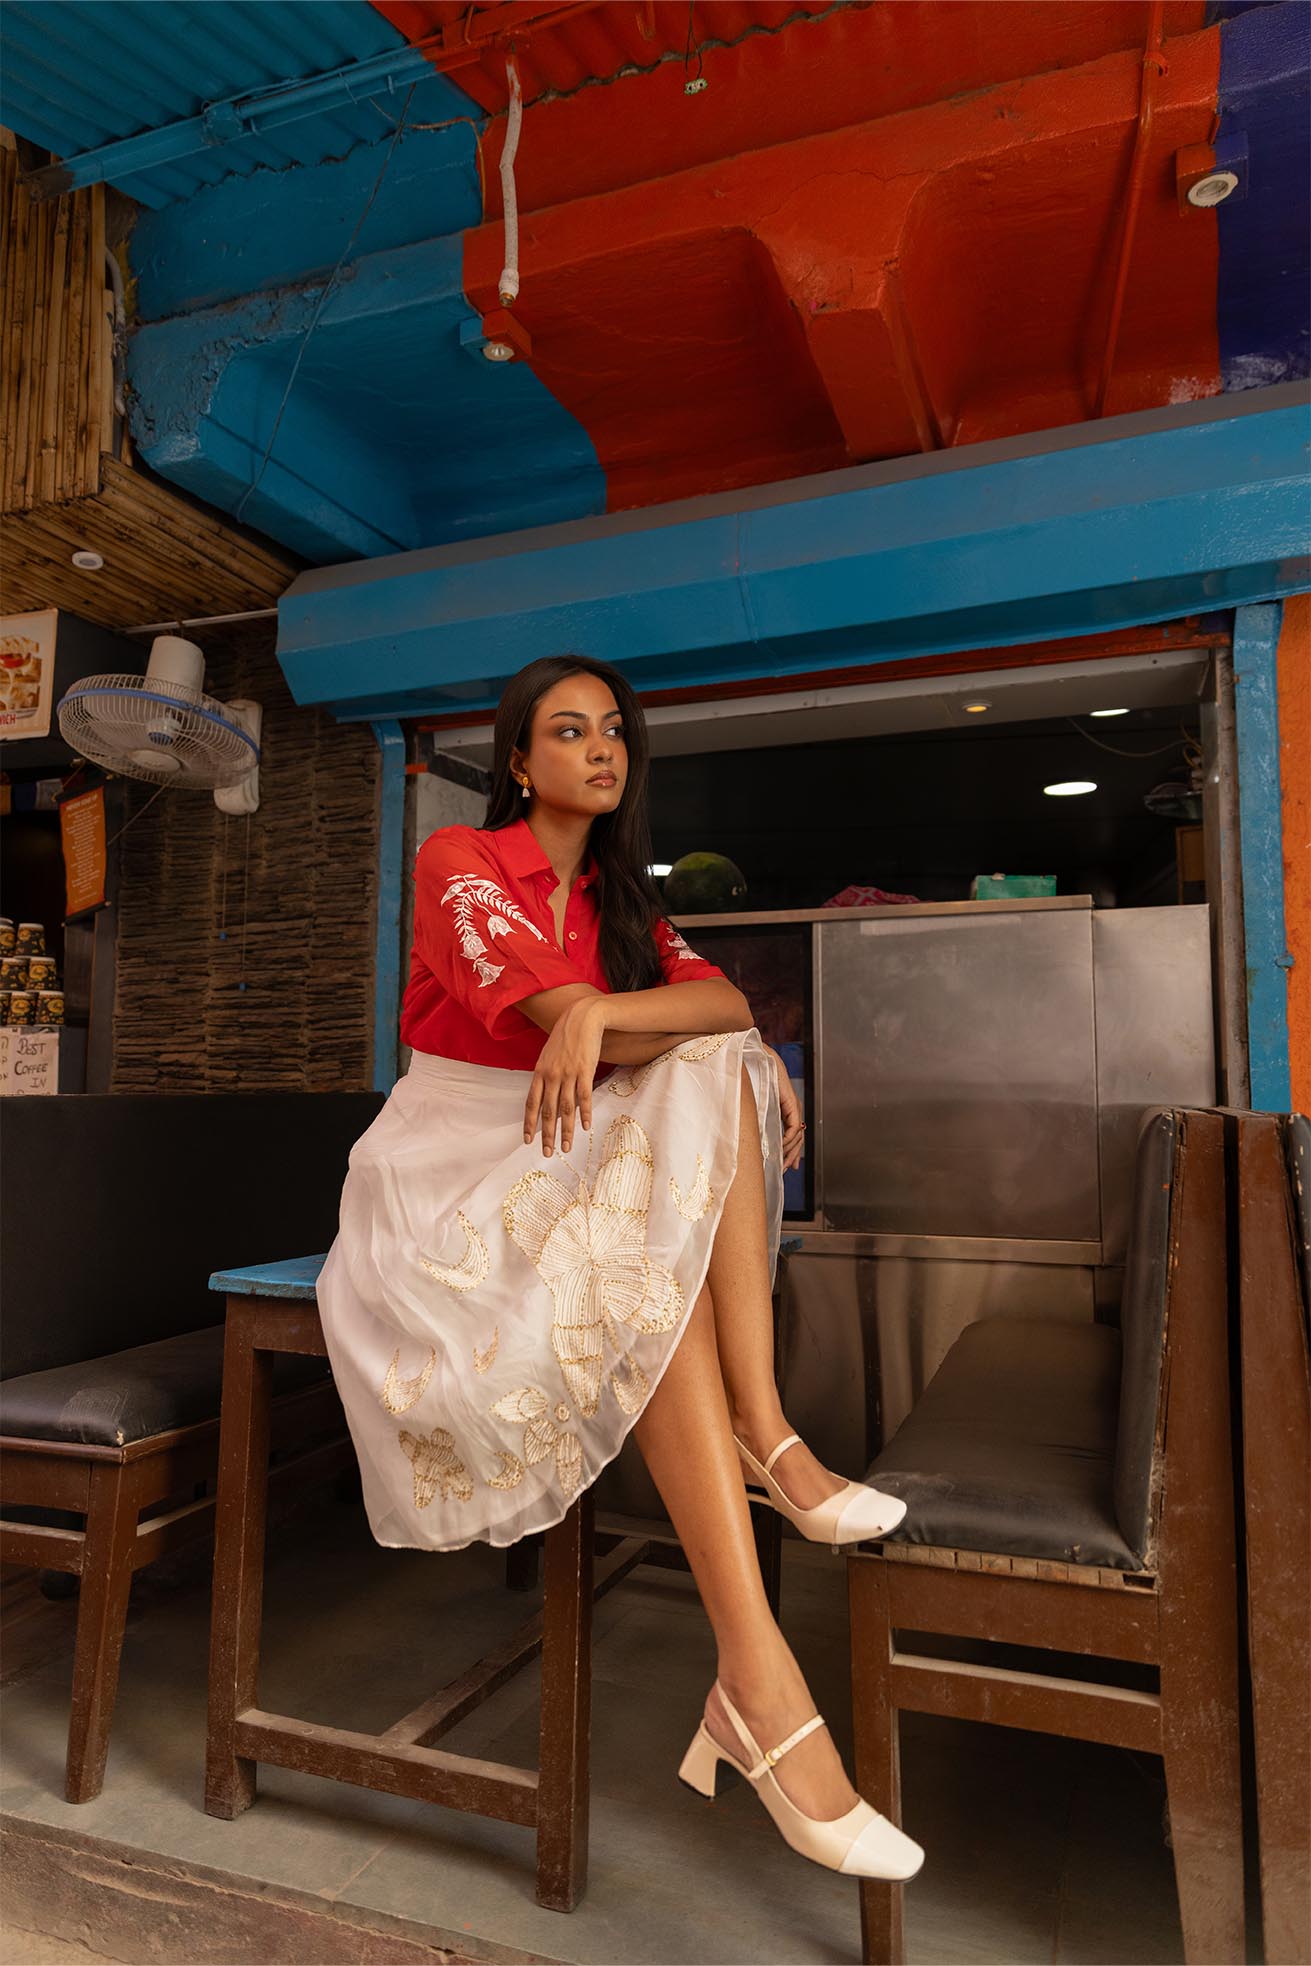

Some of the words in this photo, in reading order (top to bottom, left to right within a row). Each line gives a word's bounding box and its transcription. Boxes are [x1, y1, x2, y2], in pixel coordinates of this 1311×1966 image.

[17, 1037, 47, 1056] BEST
[14, 1060, 48, 1076] COFFEE
[30, 1077, 47, 1088] IN
